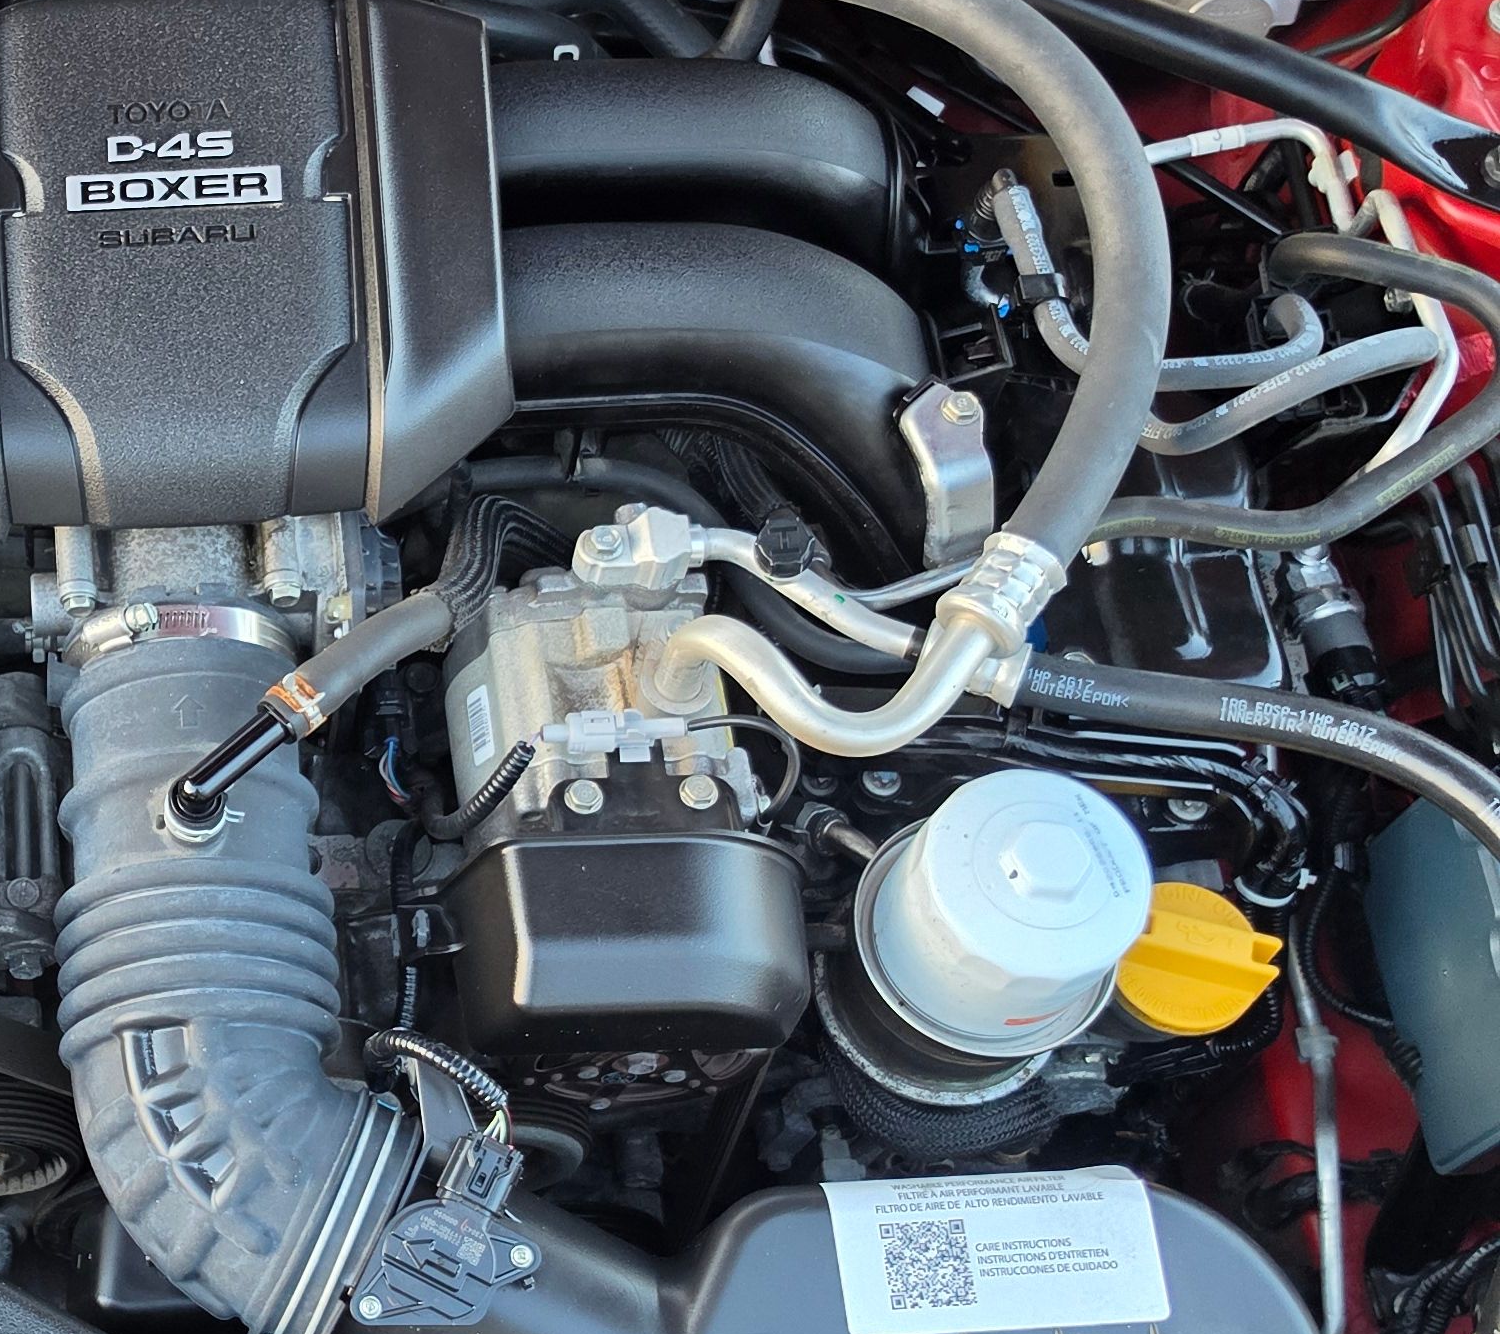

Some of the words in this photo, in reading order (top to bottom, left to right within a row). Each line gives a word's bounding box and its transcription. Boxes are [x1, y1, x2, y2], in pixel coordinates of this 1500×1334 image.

[107, 98, 231, 125] TOYOTA
[107, 130, 234, 163] D-4S
[80, 172, 269, 205] BOXER
[98, 224, 257, 249] SUBARU
[875, 1203, 908, 1214] FILTRO
[909, 1202, 923, 1212] DE
[924, 1201, 946, 1211] AIRE
[947, 1200, 960, 1210] DE
[964, 1198, 989, 1209] ALTO
[991, 1194, 1058, 1207] RENDIMIENTO
[1062, 1191, 1104, 1203] LAVABLE
[898, 1191, 929, 1200] FILTRE
[939, 1189, 954, 1198] AIR
[956, 1185, 1020, 1197] PERFORMANT
[1021, 1183, 1065, 1193] LAVABLE
[975, 1242, 1000, 1253] CARE
[1002, 1238, 1071, 1250] INSTRUCTIONS
[977, 1252, 1047, 1265] INSTRUCTIONS
[1049, 1248, 1110, 1260] D'ENTRETIEN
[979, 1264, 1055, 1278] INSTRUCCIONES
[1056, 1263, 1071, 1273] DE
[1072, 1260, 1118, 1272] CUIDADO
